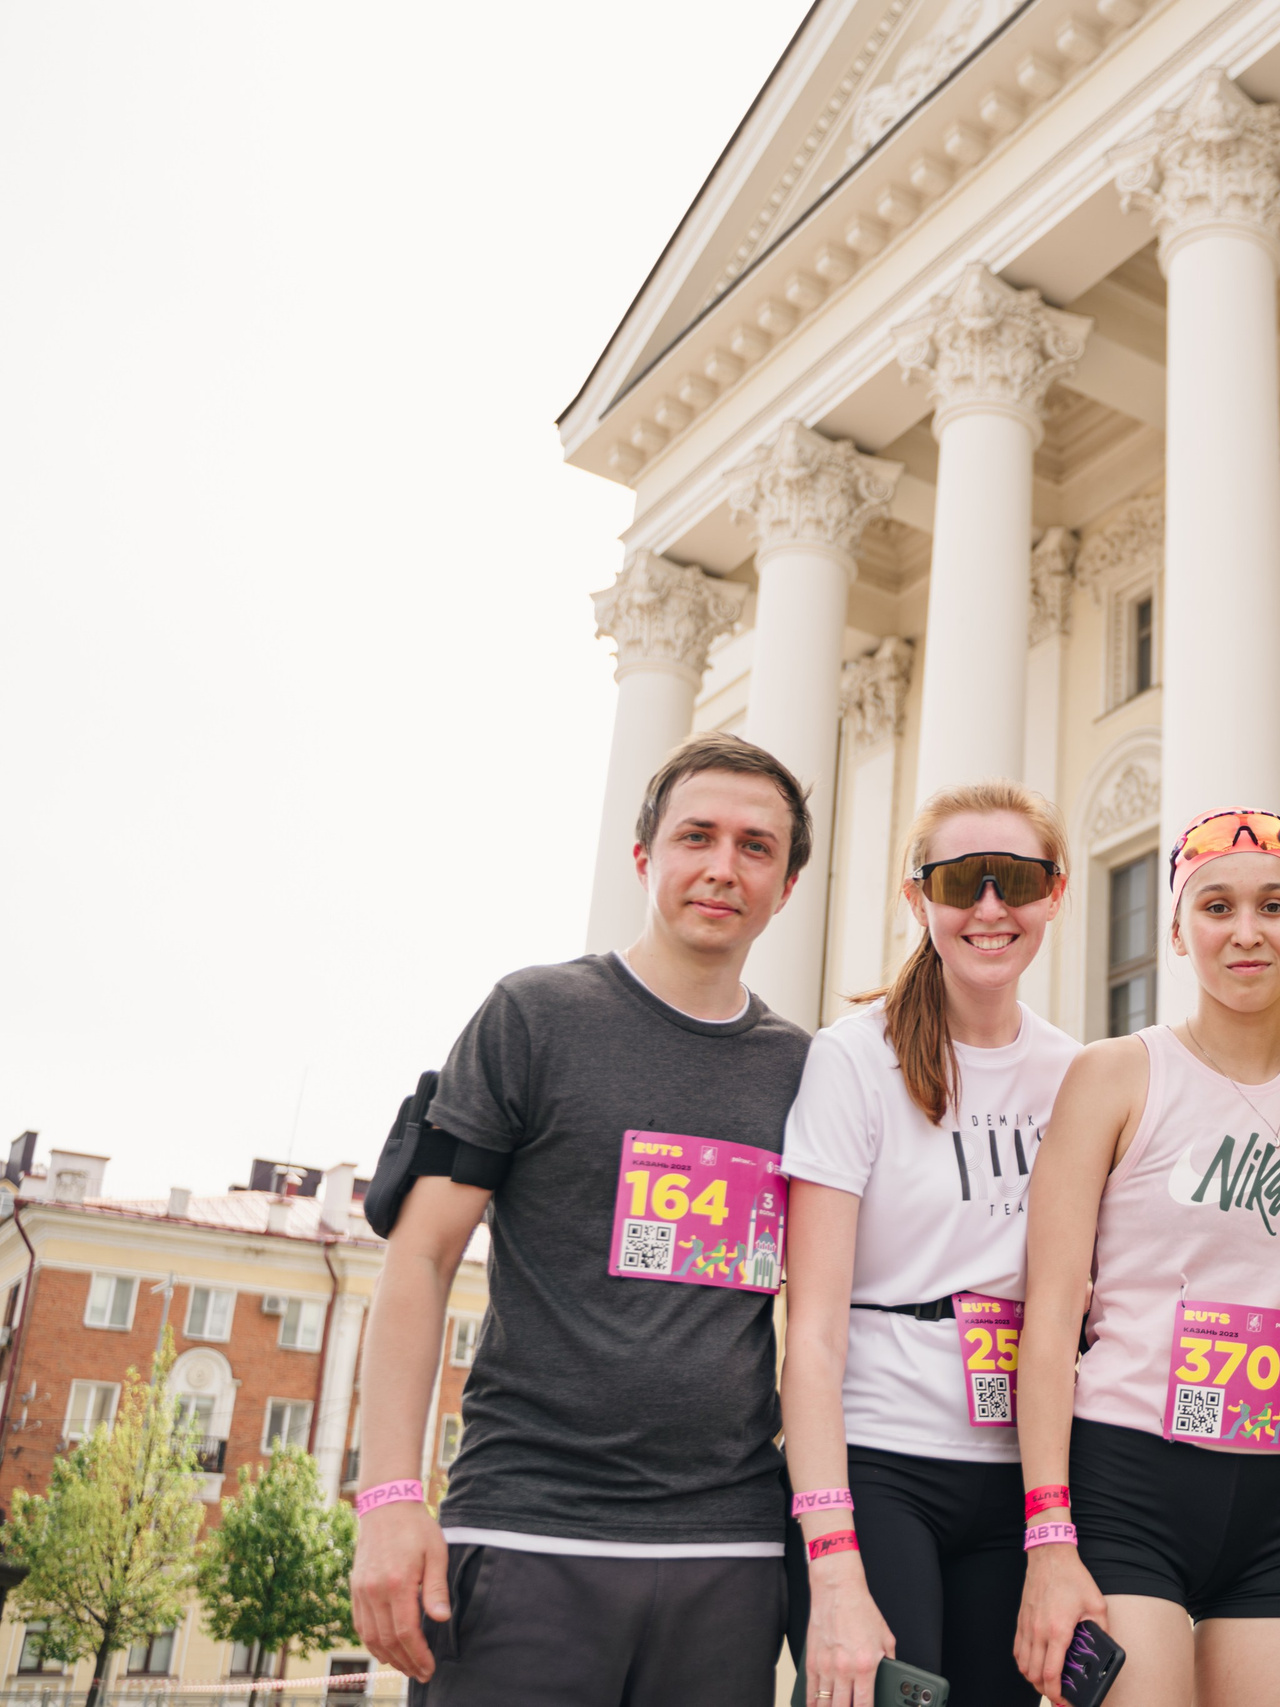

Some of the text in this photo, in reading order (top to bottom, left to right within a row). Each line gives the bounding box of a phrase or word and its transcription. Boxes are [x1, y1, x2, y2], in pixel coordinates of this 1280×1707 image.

[971, 1114, 1035, 1127] DEMIX
[632, 1142, 684, 1158] RUTS
[670, 1163, 692, 1171] 2023
[625, 1170, 729, 1226] 164
[763, 1193, 774, 1209] 3
[961, 1302, 1002, 1313] RUTS
[1184, 1310, 1231, 1325] RUTS
[1183, 1327, 1218, 1336] КАЗАНЬ
[1175, 1336, 1280, 1391] 370
